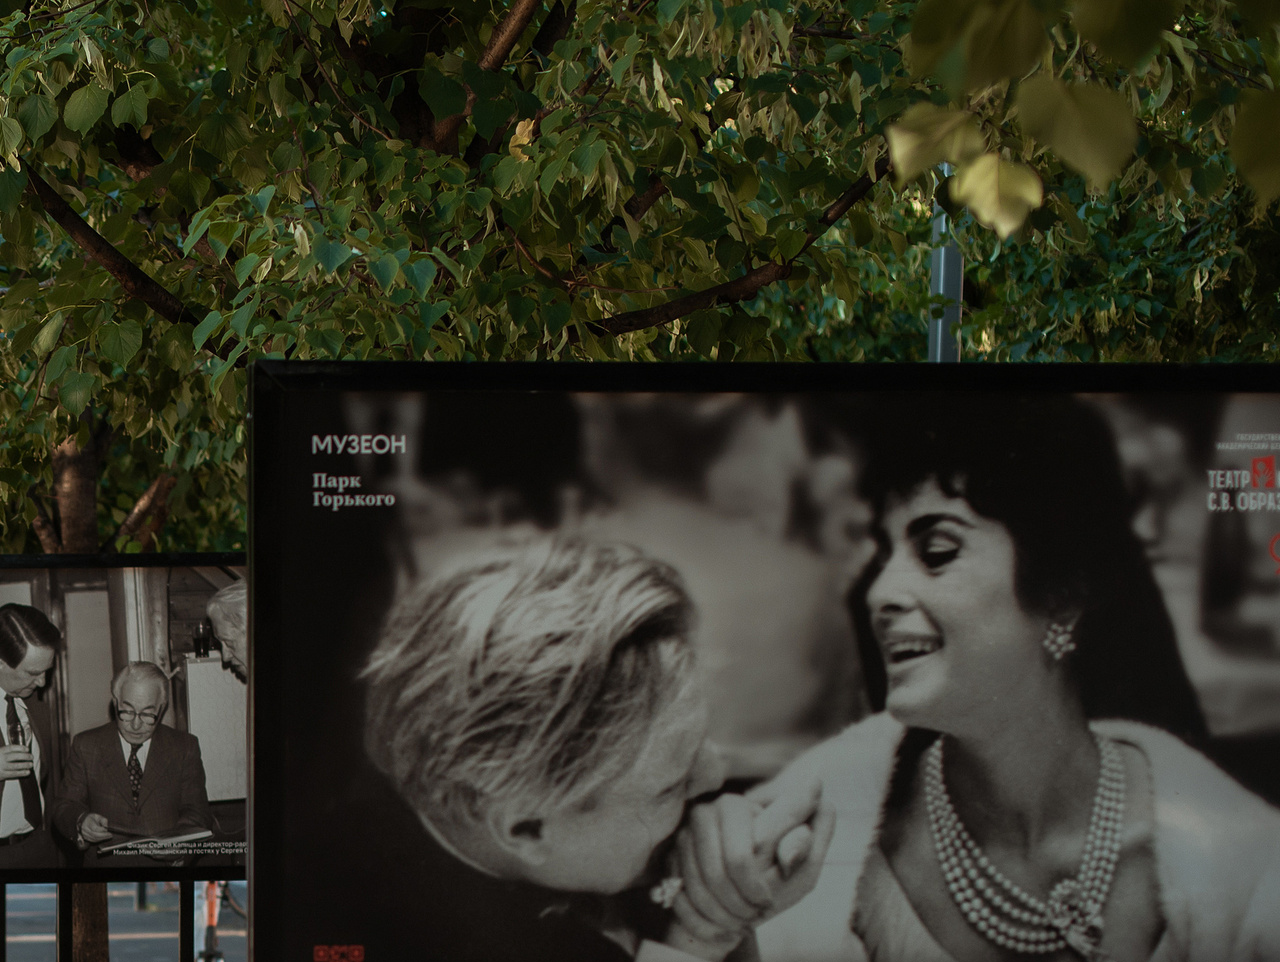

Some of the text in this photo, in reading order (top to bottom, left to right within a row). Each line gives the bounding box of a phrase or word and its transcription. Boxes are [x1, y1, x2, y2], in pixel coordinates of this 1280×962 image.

[312, 435, 406, 454] МУЗЕОН
[312, 473, 361, 493] Парк
[1208, 469, 1251, 489] ТЕАТР
[312, 491, 396, 512] Горького
[1207, 492, 1234, 511] С.В.
[148, 841, 172, 849] Сергей
[220, 847, 243, 855] Сергея
